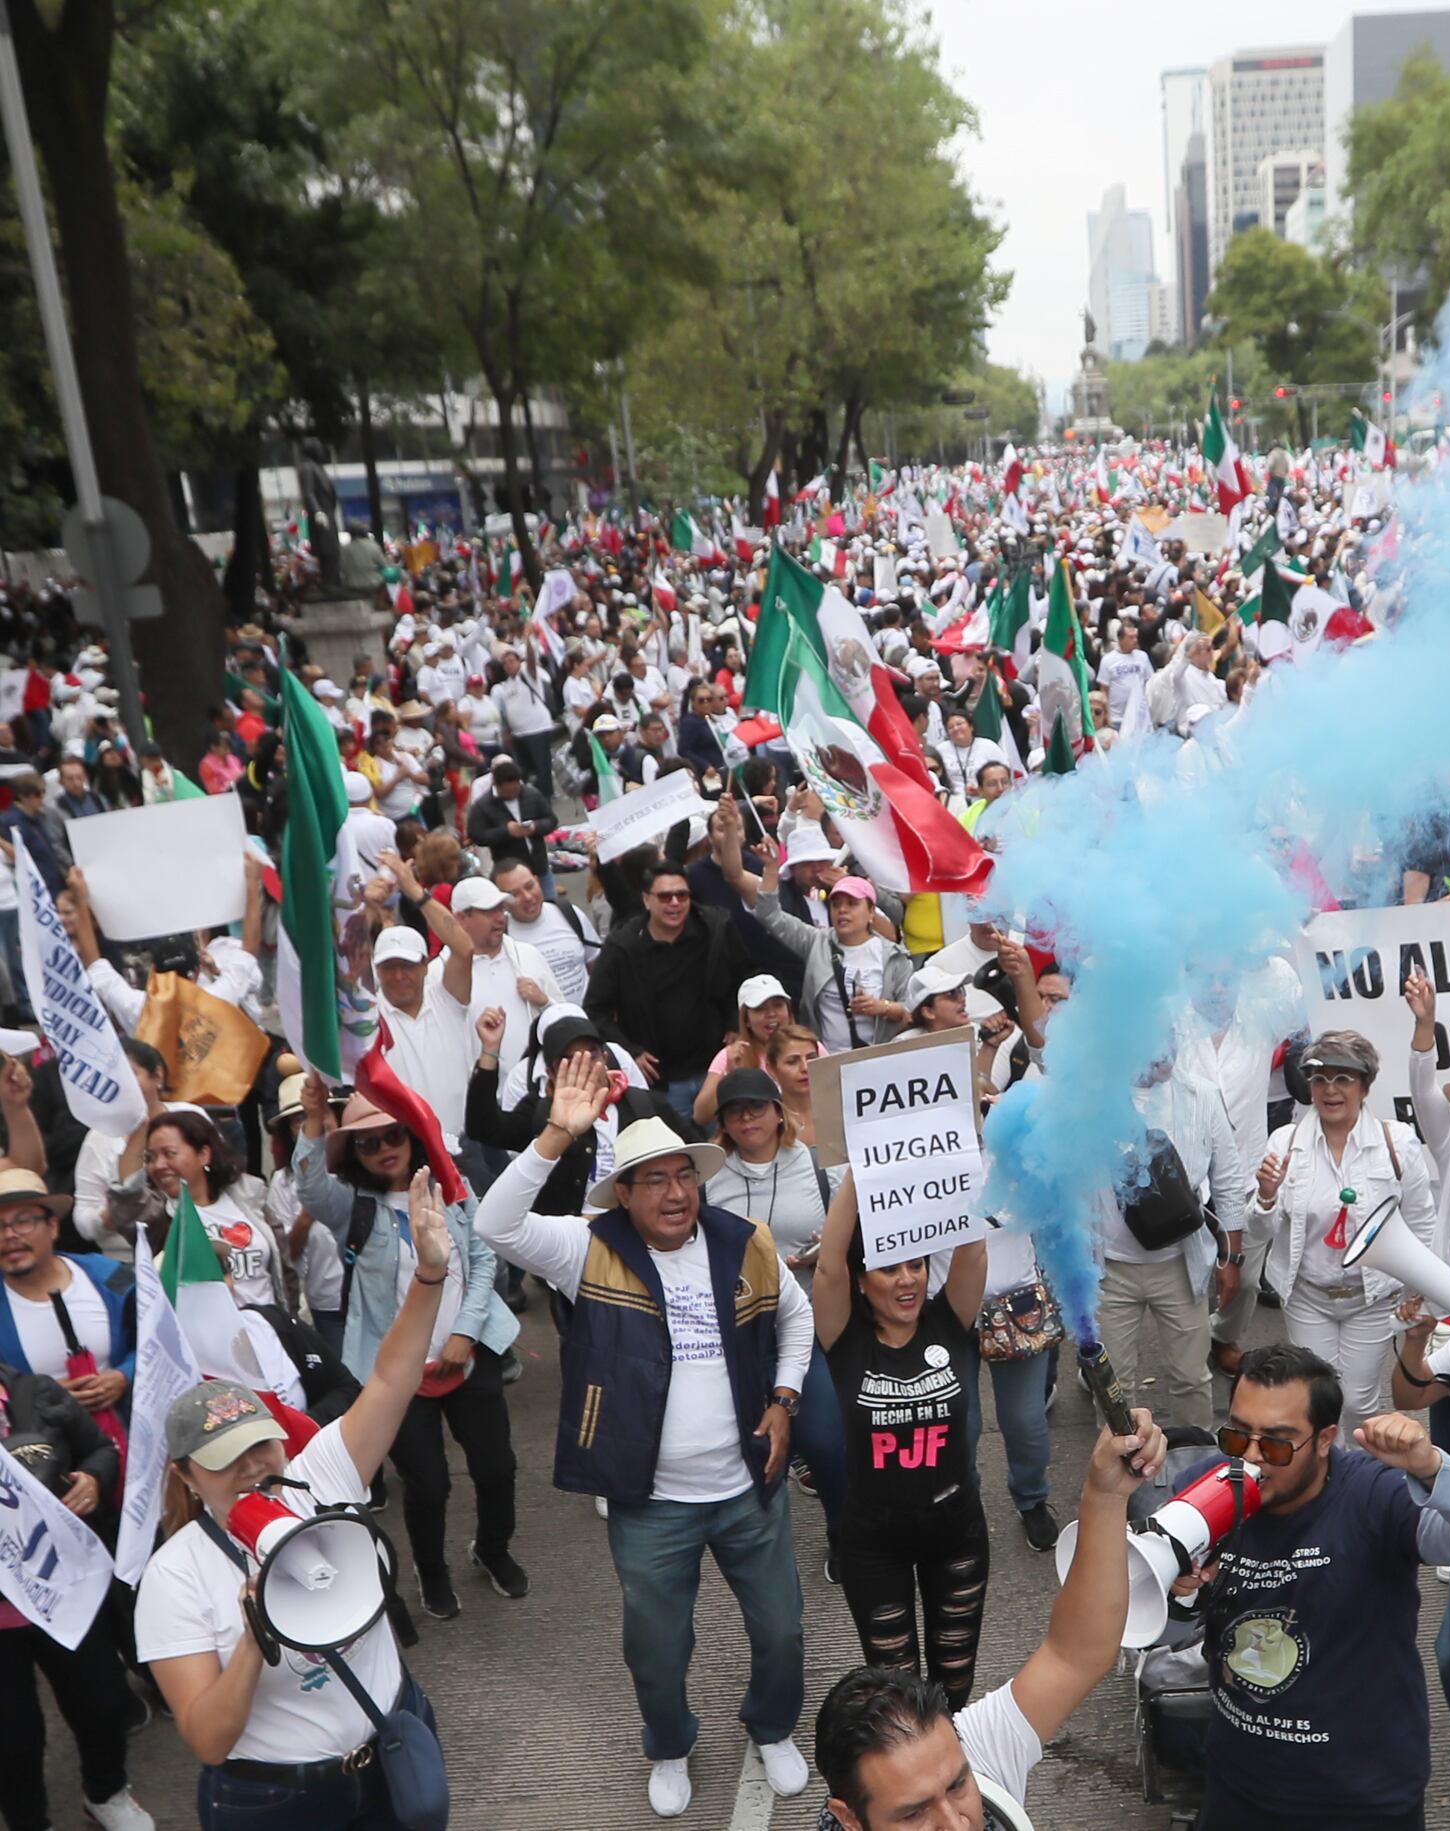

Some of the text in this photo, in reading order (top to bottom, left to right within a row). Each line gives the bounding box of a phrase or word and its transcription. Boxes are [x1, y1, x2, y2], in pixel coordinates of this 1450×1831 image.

[46, 945, 83, 986] SIN
[1316, 946, 1385, 1000] NO
[856, 1073, 958, 1117] PARA
[863, 1131, 962, 1168] JUZGAR
[870, 1173, 971, 1212] HAY QUE
[875, 1214, 970, 1253] ESTUDIAR
[861, 1367, 957, 1397] ORGULLOSAMENTE
[871, 1402, 951, 1426] HECHA EN EL
[871, 1425, 949, 1470] PJF
[1241, 1722, 1263, 1737] TUS
[1265, 1728, 1330, 1745] DERECHOS
[1256, 1715, 1271, 1726] AL
[1273, 1718, 1293, 1731] PJF
[1296, 1720, 1311, 1732] ES
